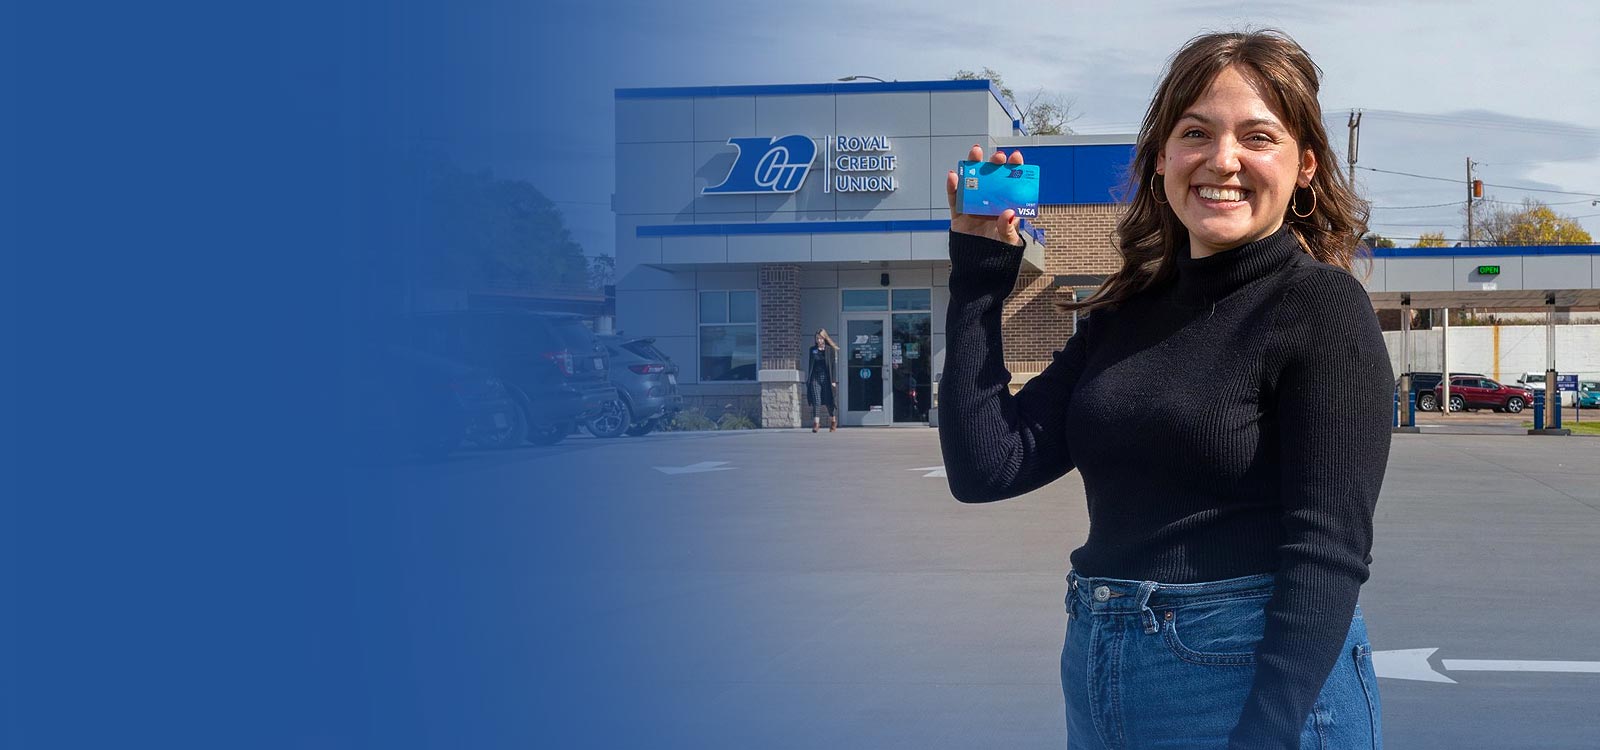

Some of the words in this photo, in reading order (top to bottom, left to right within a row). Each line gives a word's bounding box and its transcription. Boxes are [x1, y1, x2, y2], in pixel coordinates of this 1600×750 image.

[836, 135, 890, 151] ROYAL
[835, 155, 894, 171] CREDIT
[836, 176, 893, 191] UNION
[1017, 208, 1036, 216] VISA
